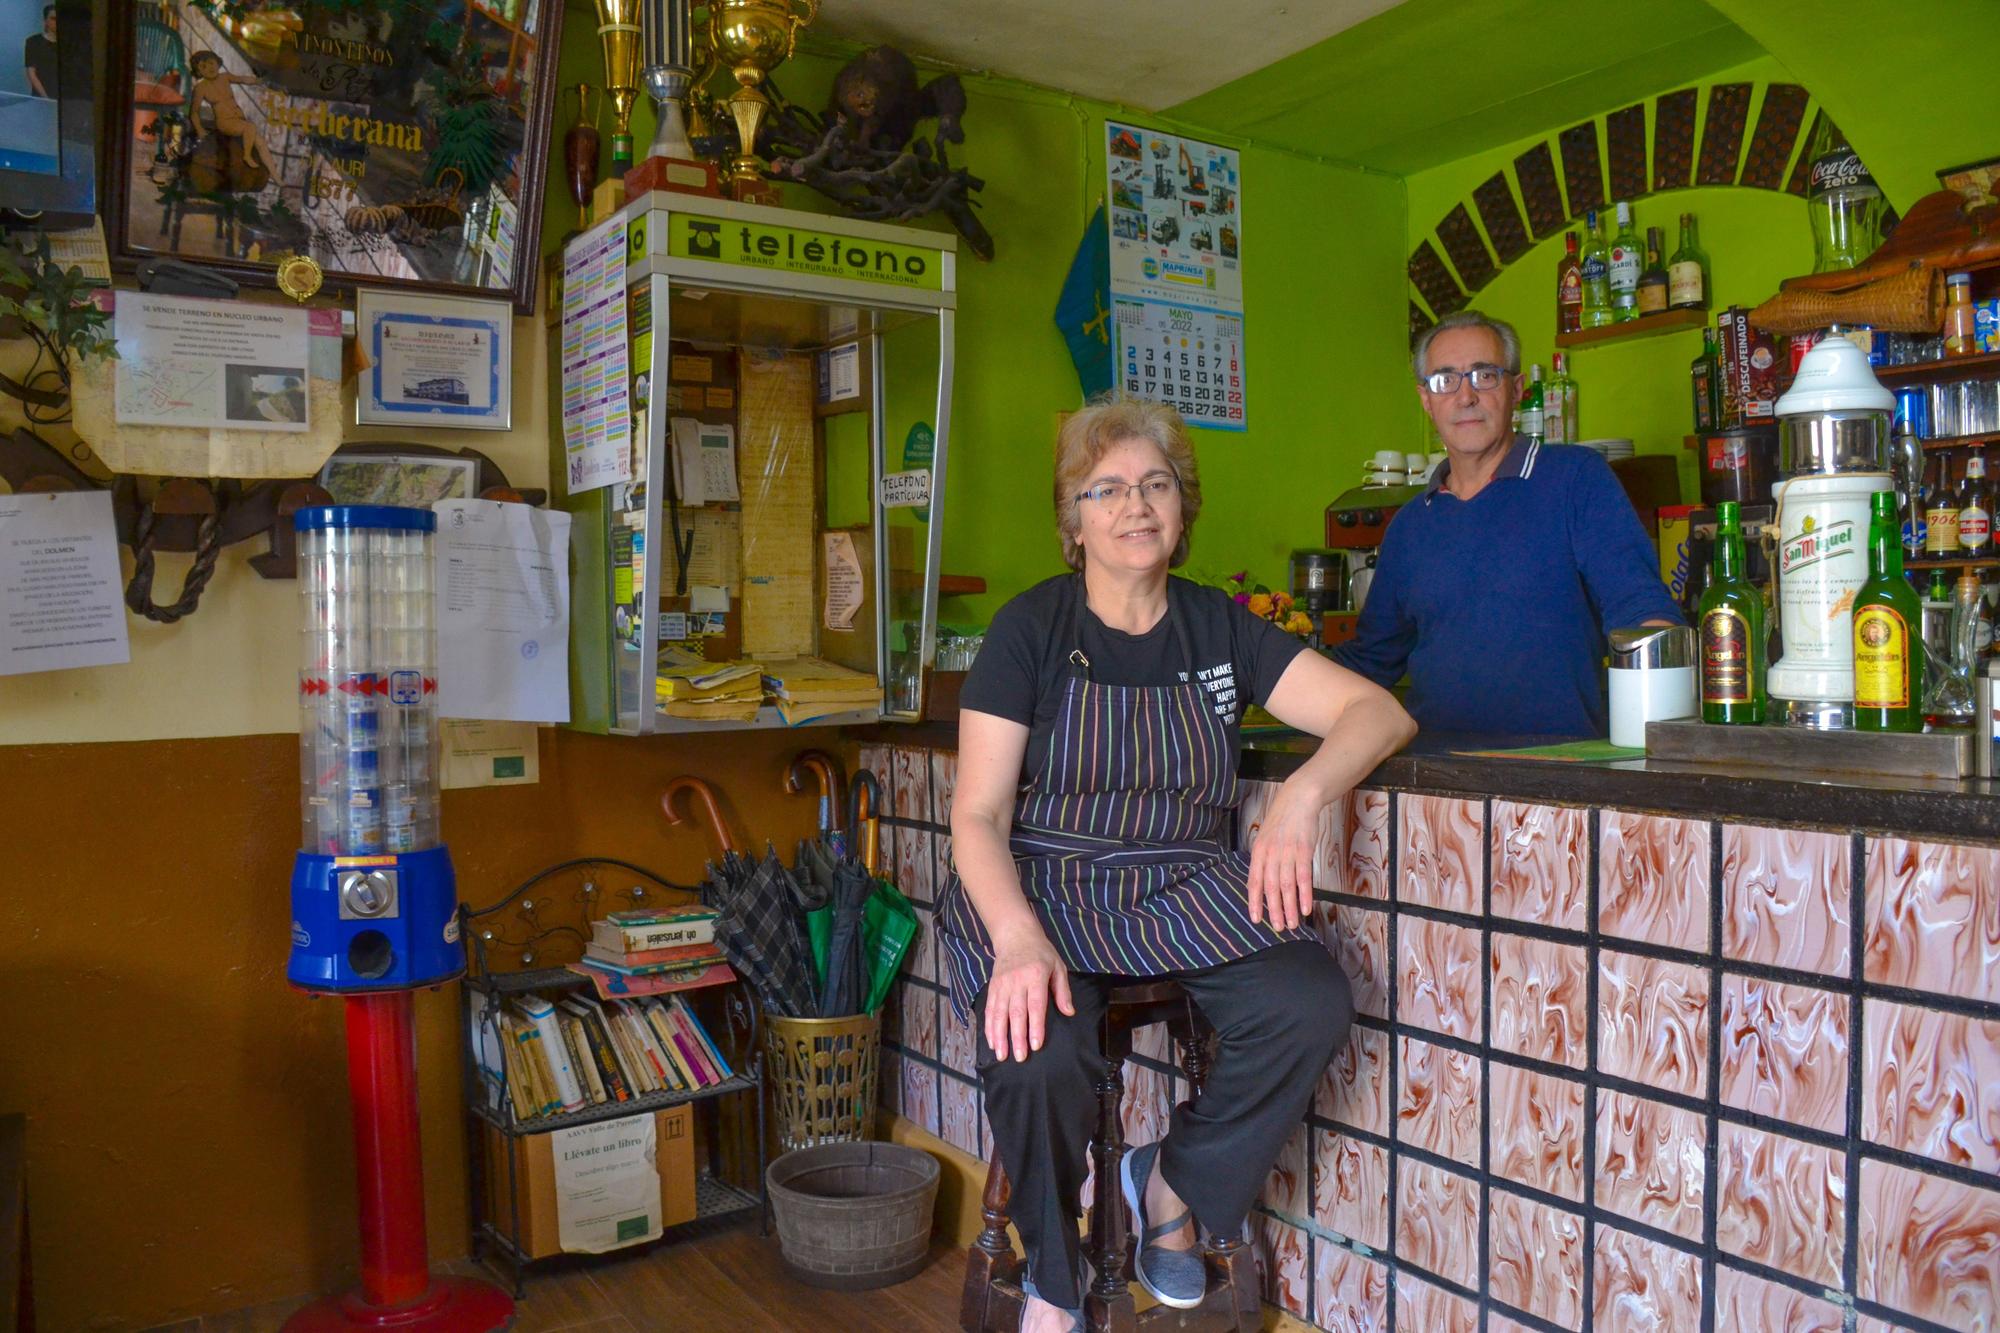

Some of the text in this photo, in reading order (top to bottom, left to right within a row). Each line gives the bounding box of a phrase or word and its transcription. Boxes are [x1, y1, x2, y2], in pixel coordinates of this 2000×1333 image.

[265, 89, 424, 152] Berberana
[310, 175, 359, 201] 1877
[1824, 175, 1858, 189] zero
[740, 227, 926, 275] teléfono
[740, 255, 918, 284] URBANO INTERURBANO INTERNACIONAL
[1161, 262, 1204, 276] MAPRINSA
[153, 306, 176, 314] VENDE
[178, 308, 212, 317] TERRENO
[253, 315, 284, 323] URBANO
[1169, 308, 1193, 321] MAYO
[1170, 319, 1193, 332] 2022
[1127, 346, 1238, 372] 2 3 4 5 6 7 8
[1736, 315, 1751, 393] DESCAFEINADO
[1127, 362, 1240, 388] 9 10 11 12 13 14 15
[1127, 379, 1242, 404] 16 17 18 19 20 21 22
[1178, 402, 1194, 414] 26
[1195, 403, 1210, 416] 27
[1212, 405, 1227, 418] 28
[1228, 407, 1242, 420] 29
[883, 475, 927, 490] TELEFONO
[1927, 514, 1957, 526] 1906
[1212, 662, 1233, 678] MAKE
[1216, 688, 1237, 703] HAPPY
[1214, 703, 1227, 715] ARE
[646, 929, 684, 945] jerusalén
[564, 1137, 642, 1160] Llévate un libro
